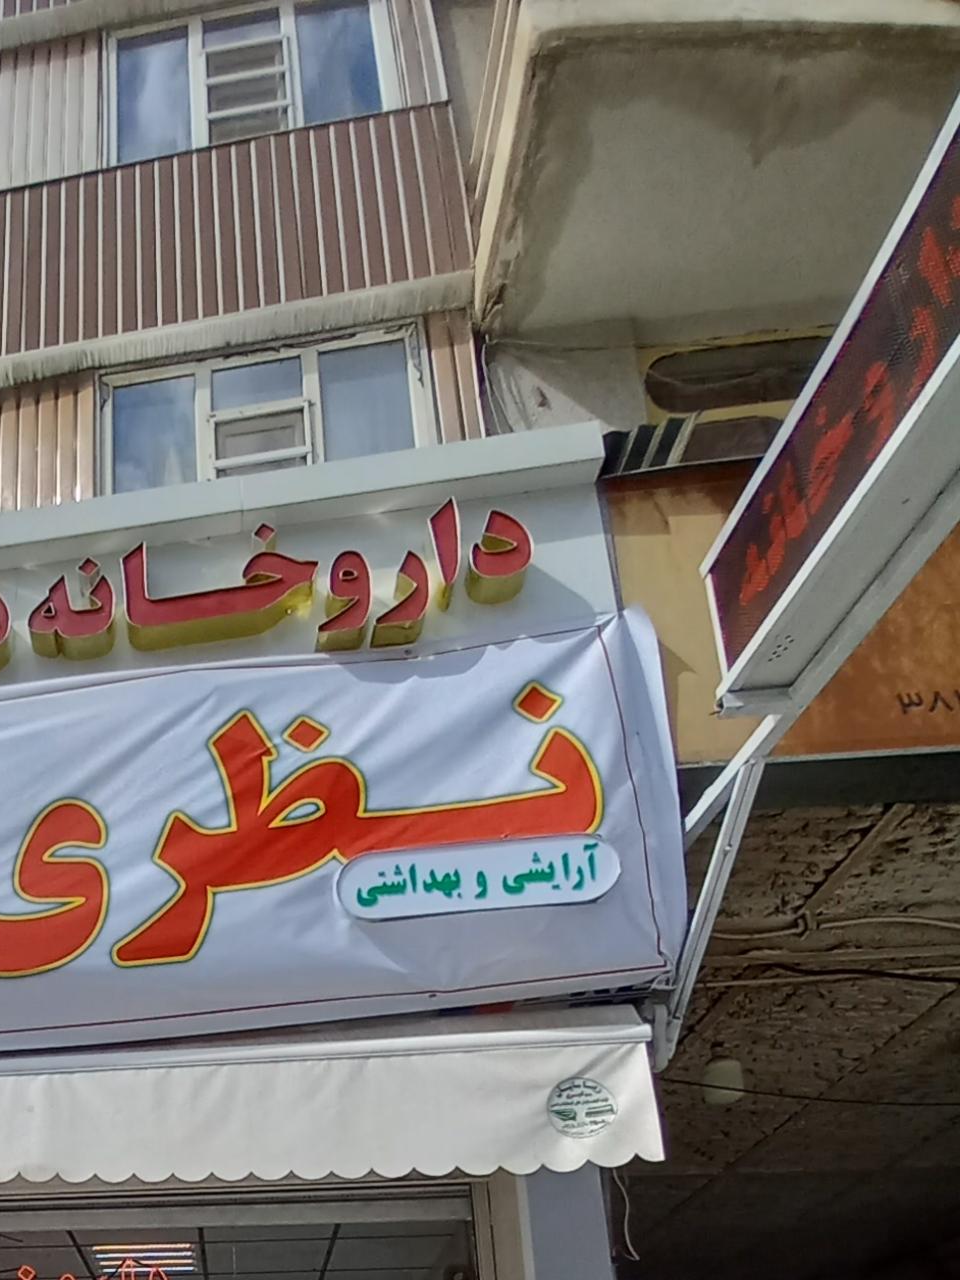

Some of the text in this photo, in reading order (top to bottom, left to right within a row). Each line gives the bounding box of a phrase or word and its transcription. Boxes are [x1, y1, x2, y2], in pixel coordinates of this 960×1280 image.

[25, 496, 534, 660] داروخانه
[356, 842, 599, 908] آرایشی و بهداشتی
